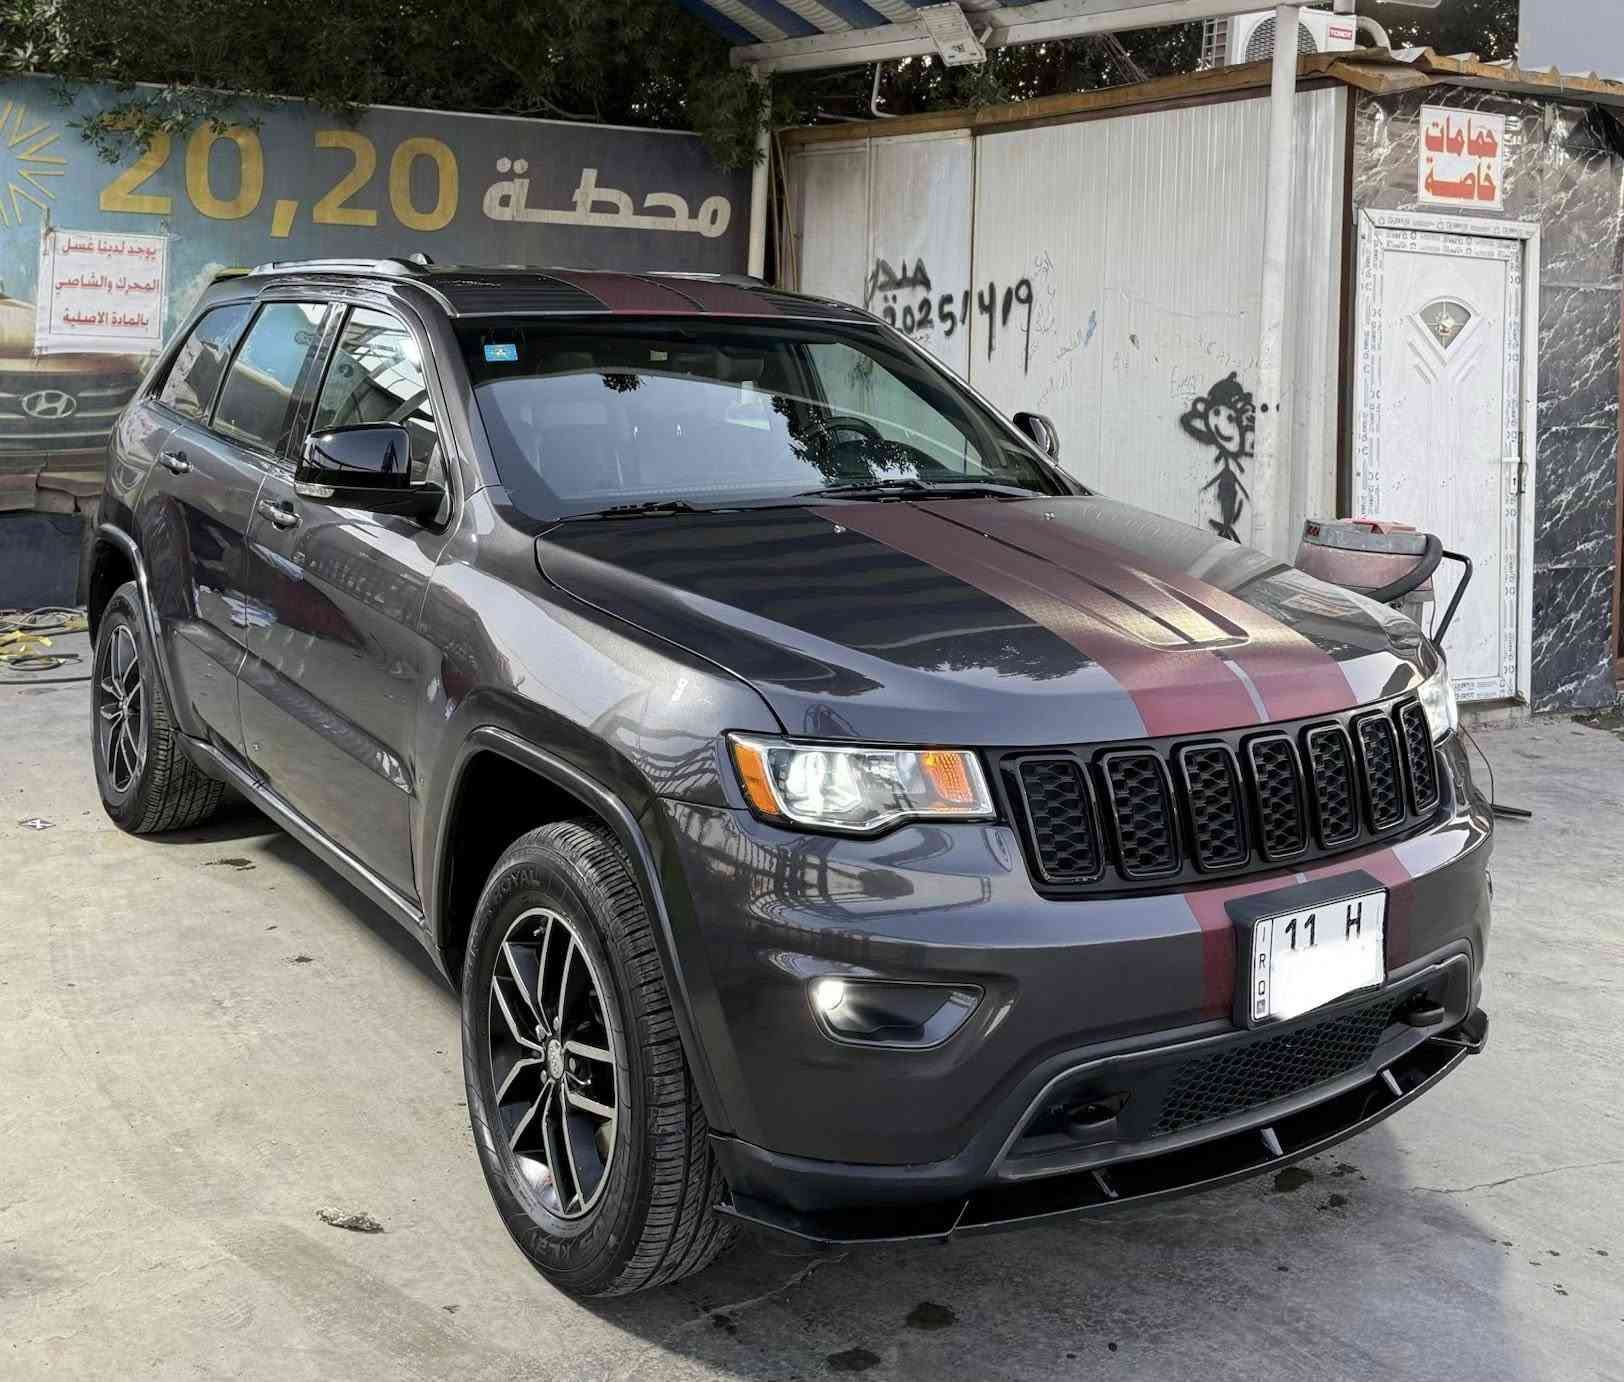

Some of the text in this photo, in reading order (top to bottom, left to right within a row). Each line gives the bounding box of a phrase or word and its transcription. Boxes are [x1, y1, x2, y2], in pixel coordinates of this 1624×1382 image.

[1425, 114, 1497, 158] حمامات
[99, 107, 731, 237] محطة 20,20
[1425, 156, 1496, 201] خاصة
[63, 236, 157, 261] يوجد لدينا غسل
[55, 271, 160, 295] المحرك والشاصي
[111, 311, 149, 331] بالمادة
[1284, 901, 1363, 950] 11 H
